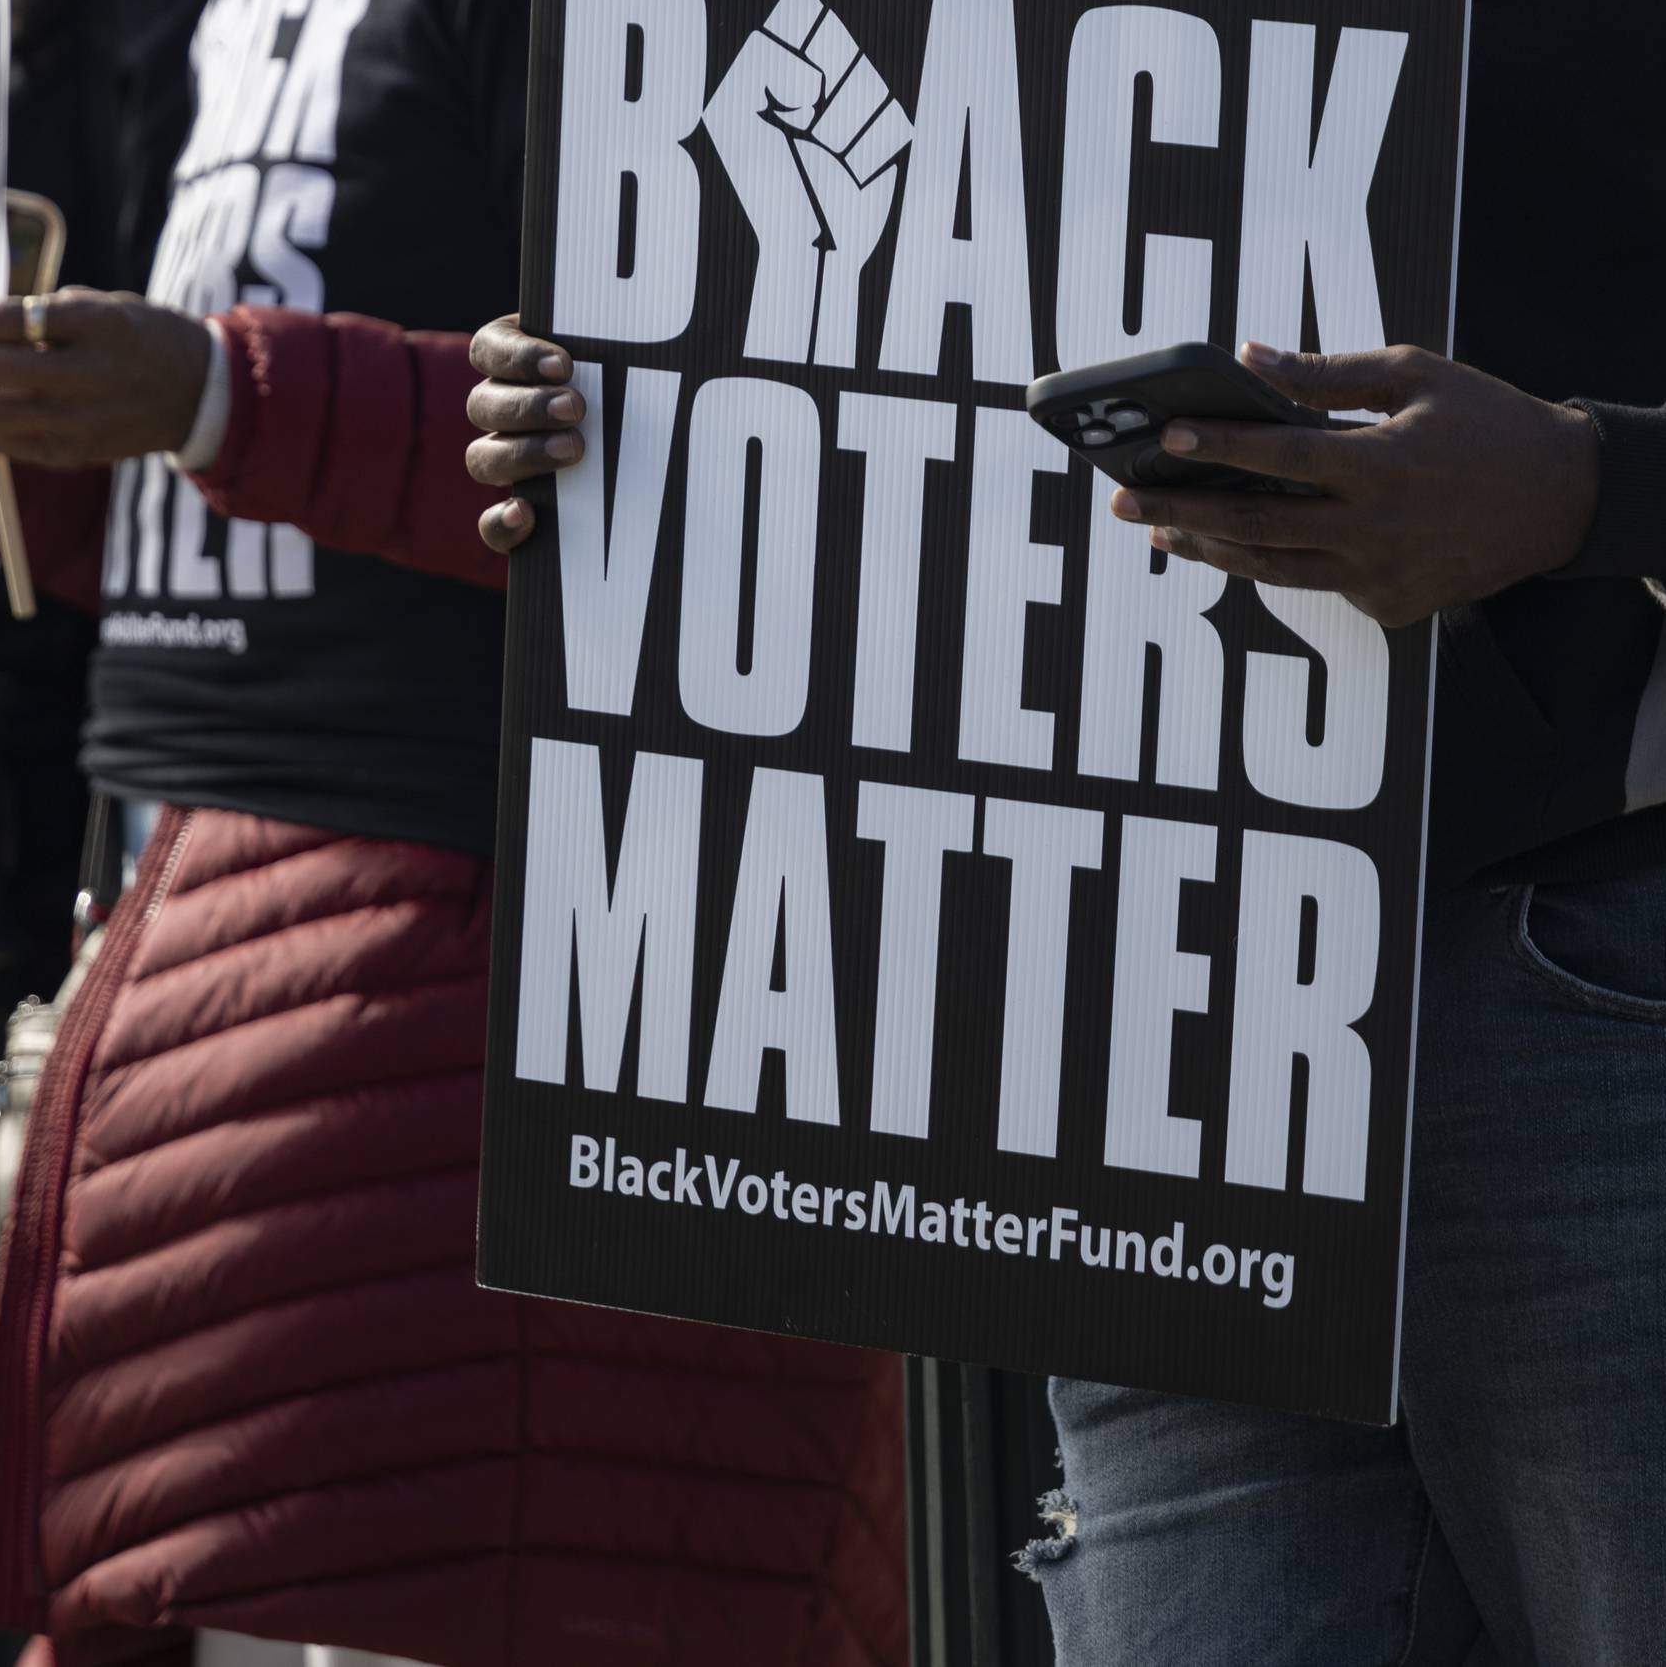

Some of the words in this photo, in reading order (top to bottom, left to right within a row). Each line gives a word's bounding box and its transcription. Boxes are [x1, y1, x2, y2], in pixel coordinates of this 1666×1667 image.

[555, 361, 1391, 810] VOTERS
[515, 736, 1382, 1203] MATTER
[570, 1134, 1295, 1309] BlackVotersMatterFund.org
